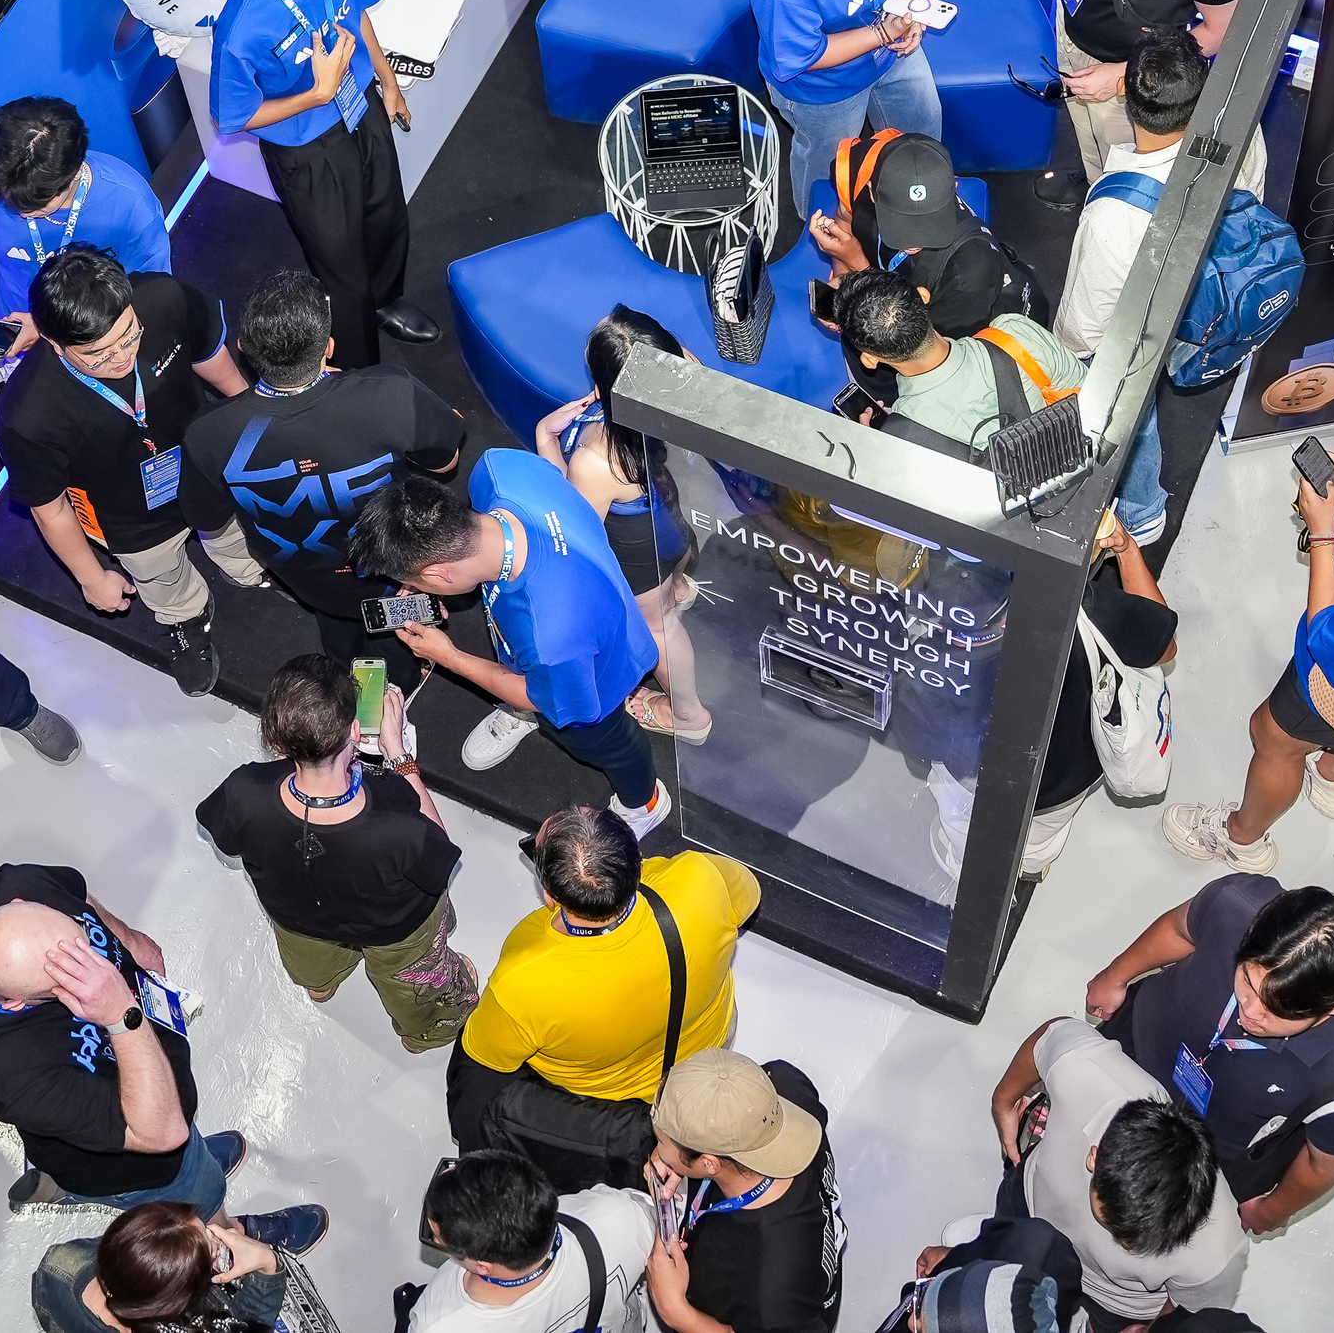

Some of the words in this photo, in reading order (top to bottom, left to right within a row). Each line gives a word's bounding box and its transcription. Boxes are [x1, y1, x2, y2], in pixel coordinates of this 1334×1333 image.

[291, 2, 310, 30] MEXC
[64, 210, 79, 238] MEXC
[499, 555, 513, 581] MEXC
[690, 508, 976, 628] EMPOWERING
[769, 586, 971, 676] THROUGH
[793, 573, 973, 653] GROWTH
[786, 616, 971, 696] SYNERGY
